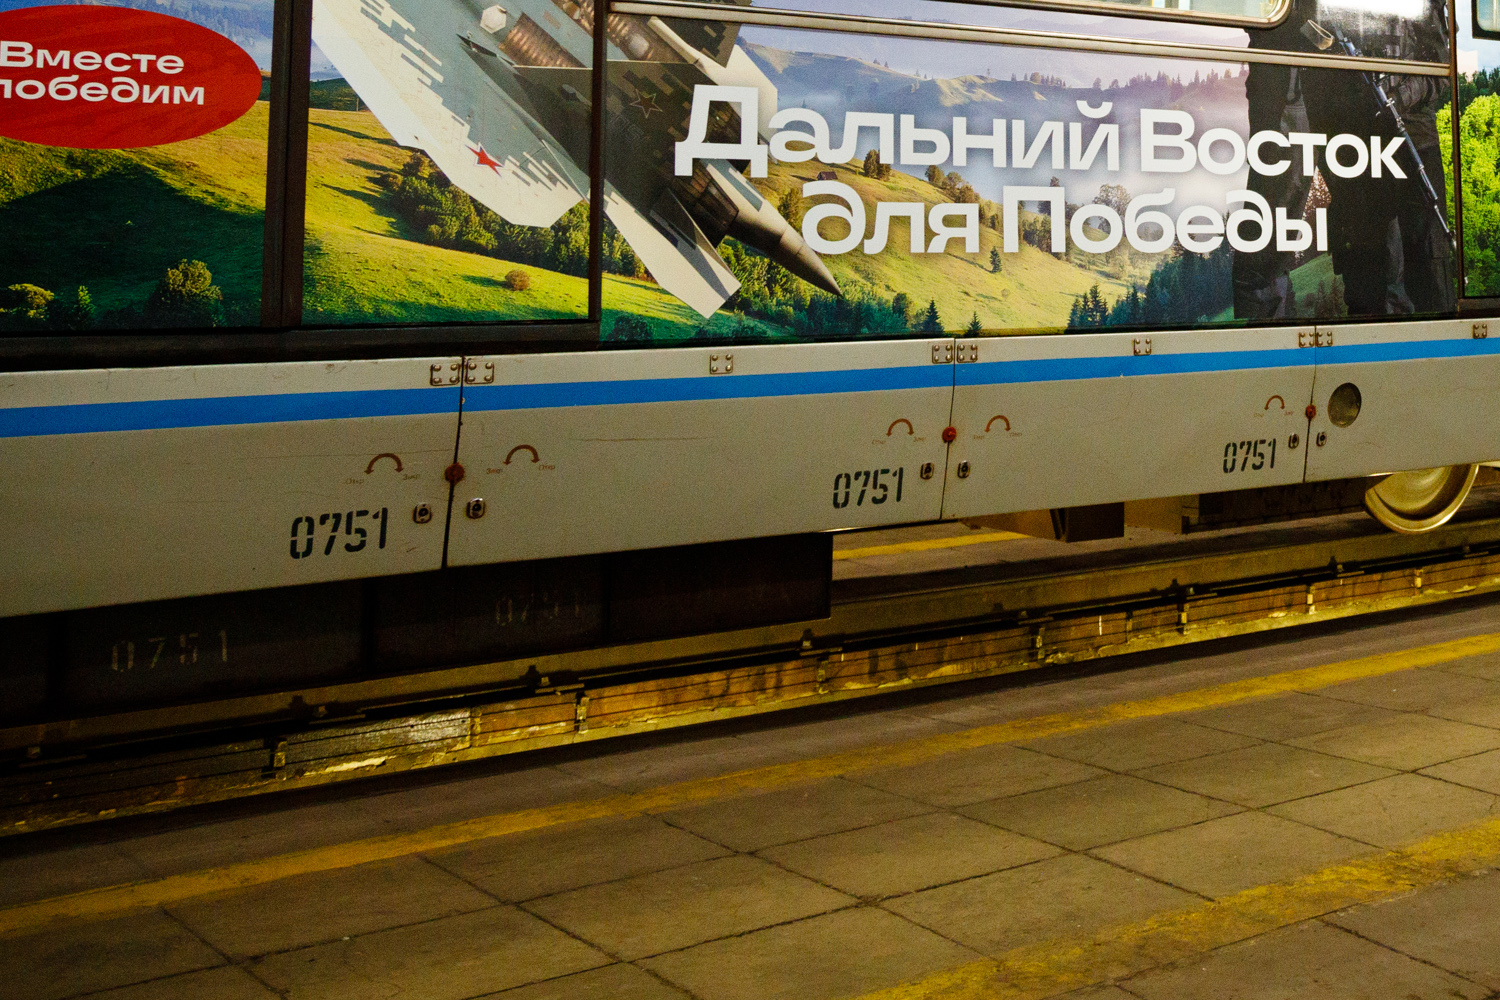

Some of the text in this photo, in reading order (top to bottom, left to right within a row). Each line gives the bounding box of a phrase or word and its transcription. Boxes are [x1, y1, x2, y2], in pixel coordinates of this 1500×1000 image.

[0, 40, 185, 75] Вместе
[673, 83, 1120, 179] Дальний
[1139, 107, 1409, 180] Восток
[801, 179, 1329, 255] для Победы
[1222, 437, 1277, 474] 0751
[832, 466, 904, 509] 0751
[289, 506, 390, 560] 0751
